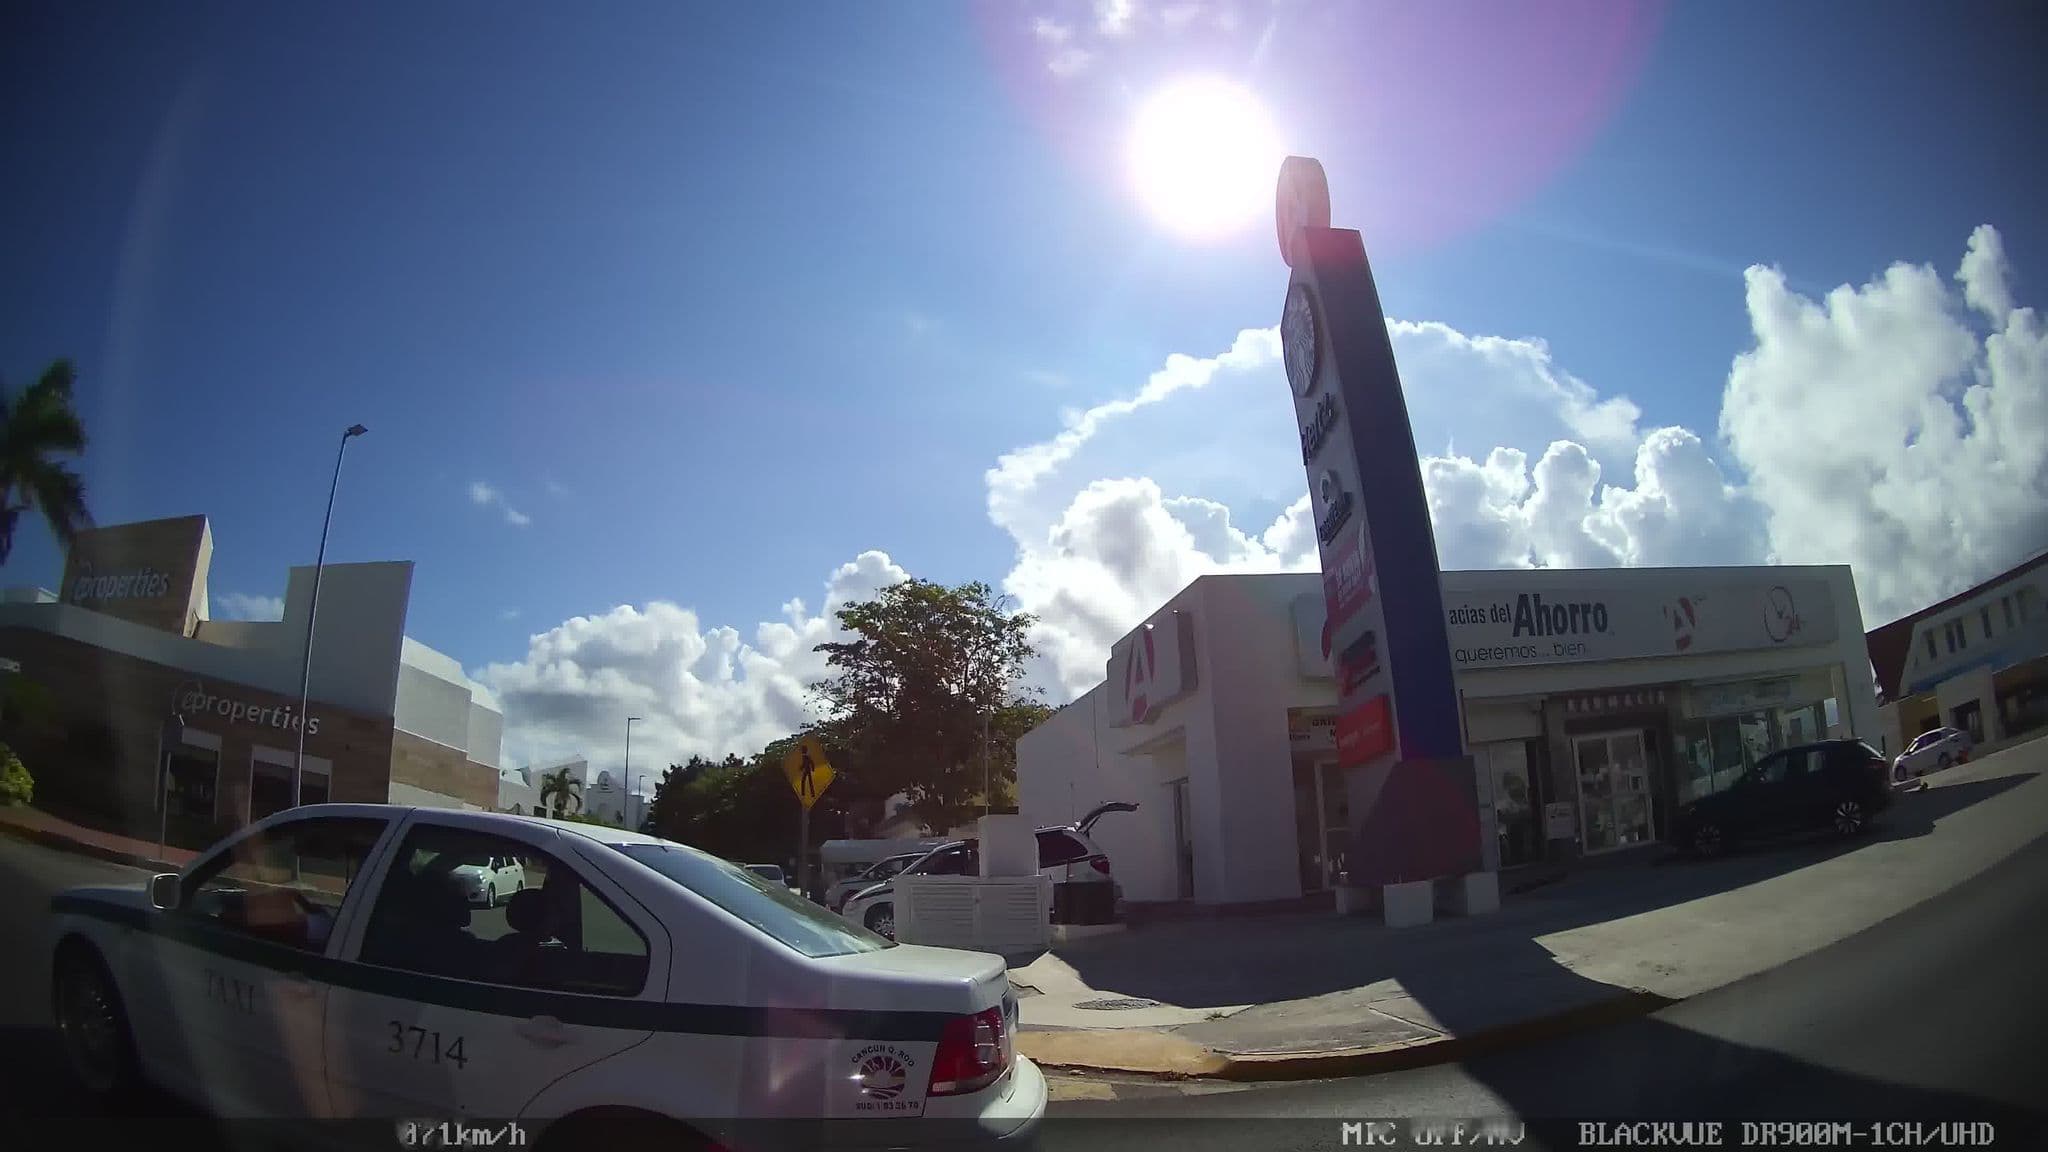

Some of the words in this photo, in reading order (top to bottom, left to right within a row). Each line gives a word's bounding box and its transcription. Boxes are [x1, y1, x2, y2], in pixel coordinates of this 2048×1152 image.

[1490, 602, 1512, 624] del
[1512, 593, 1608, 637] Ahorro
[387, 1019, 468, 1070] 3714
